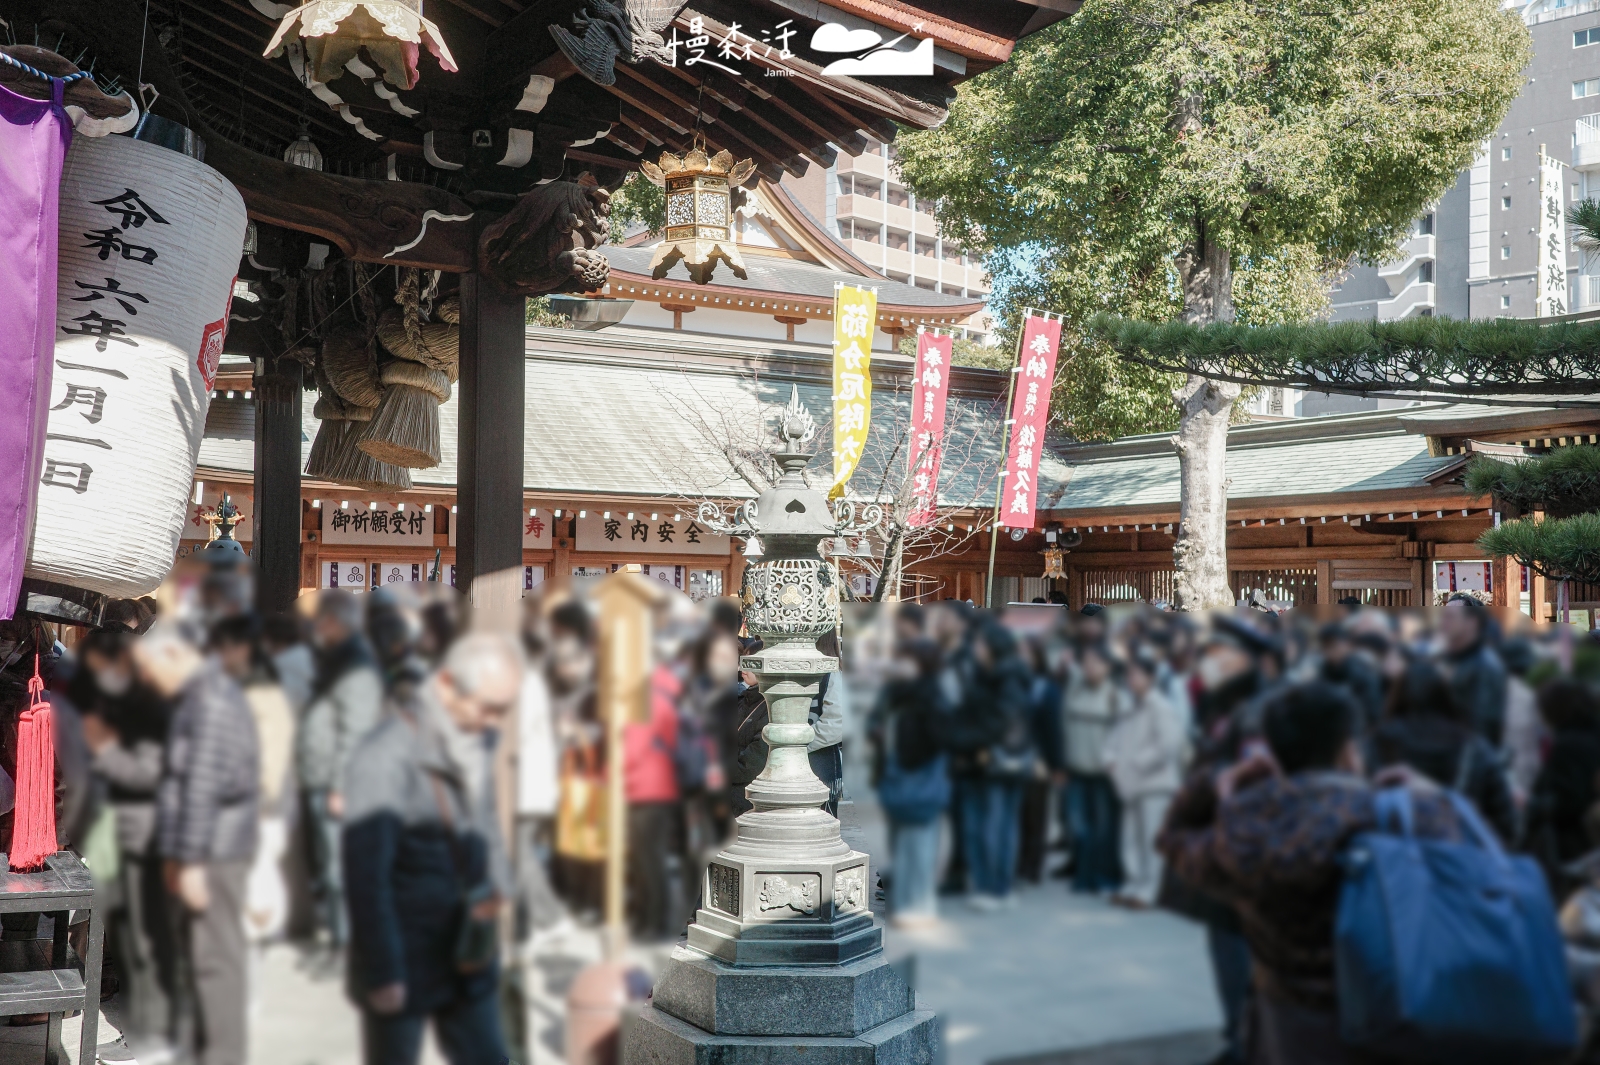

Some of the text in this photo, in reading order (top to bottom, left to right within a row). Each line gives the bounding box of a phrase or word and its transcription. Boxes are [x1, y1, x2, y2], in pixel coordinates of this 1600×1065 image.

[40, 187, 170, 495] 令和六年一月一日
[331, 508, 427, 535] 御祈願受付
[523, 512, 546, 540] 寿
[604, 518, 704, 544] 家内安全
